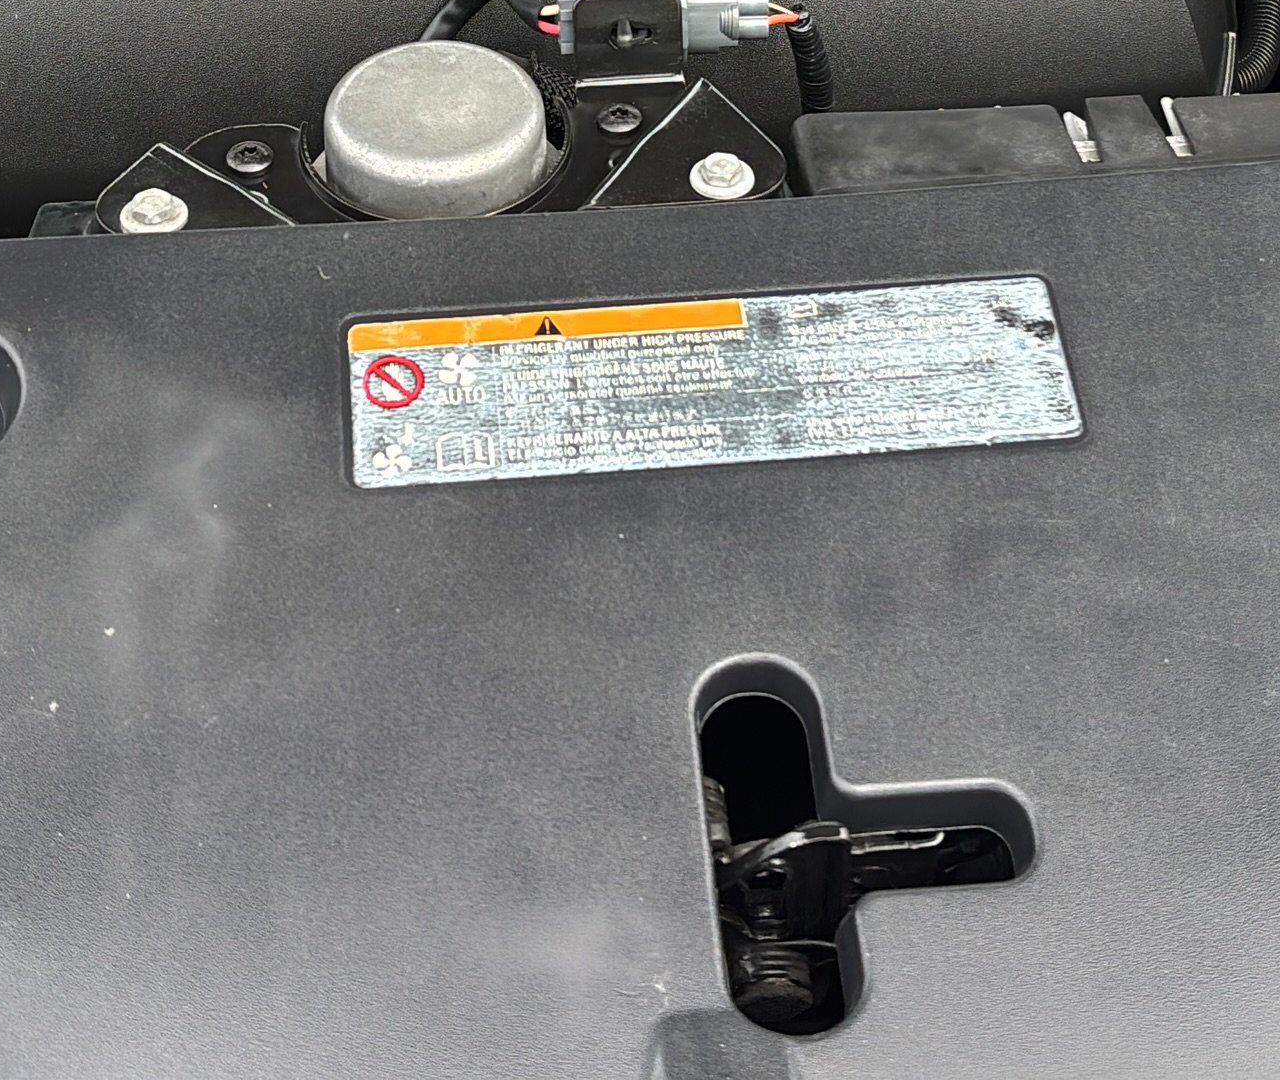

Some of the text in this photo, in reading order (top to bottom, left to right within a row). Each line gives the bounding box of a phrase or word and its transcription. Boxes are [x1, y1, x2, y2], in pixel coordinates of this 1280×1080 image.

[500, 328, 746, 356] REFRIGERANT UNDER HIGH PRESSURE
[693, 342, 719, 358] only
[642, 359, 679, 375] SOUS
[436, 386, 487, 406] AUTO
[625, 424, 660, 441] ALTA
